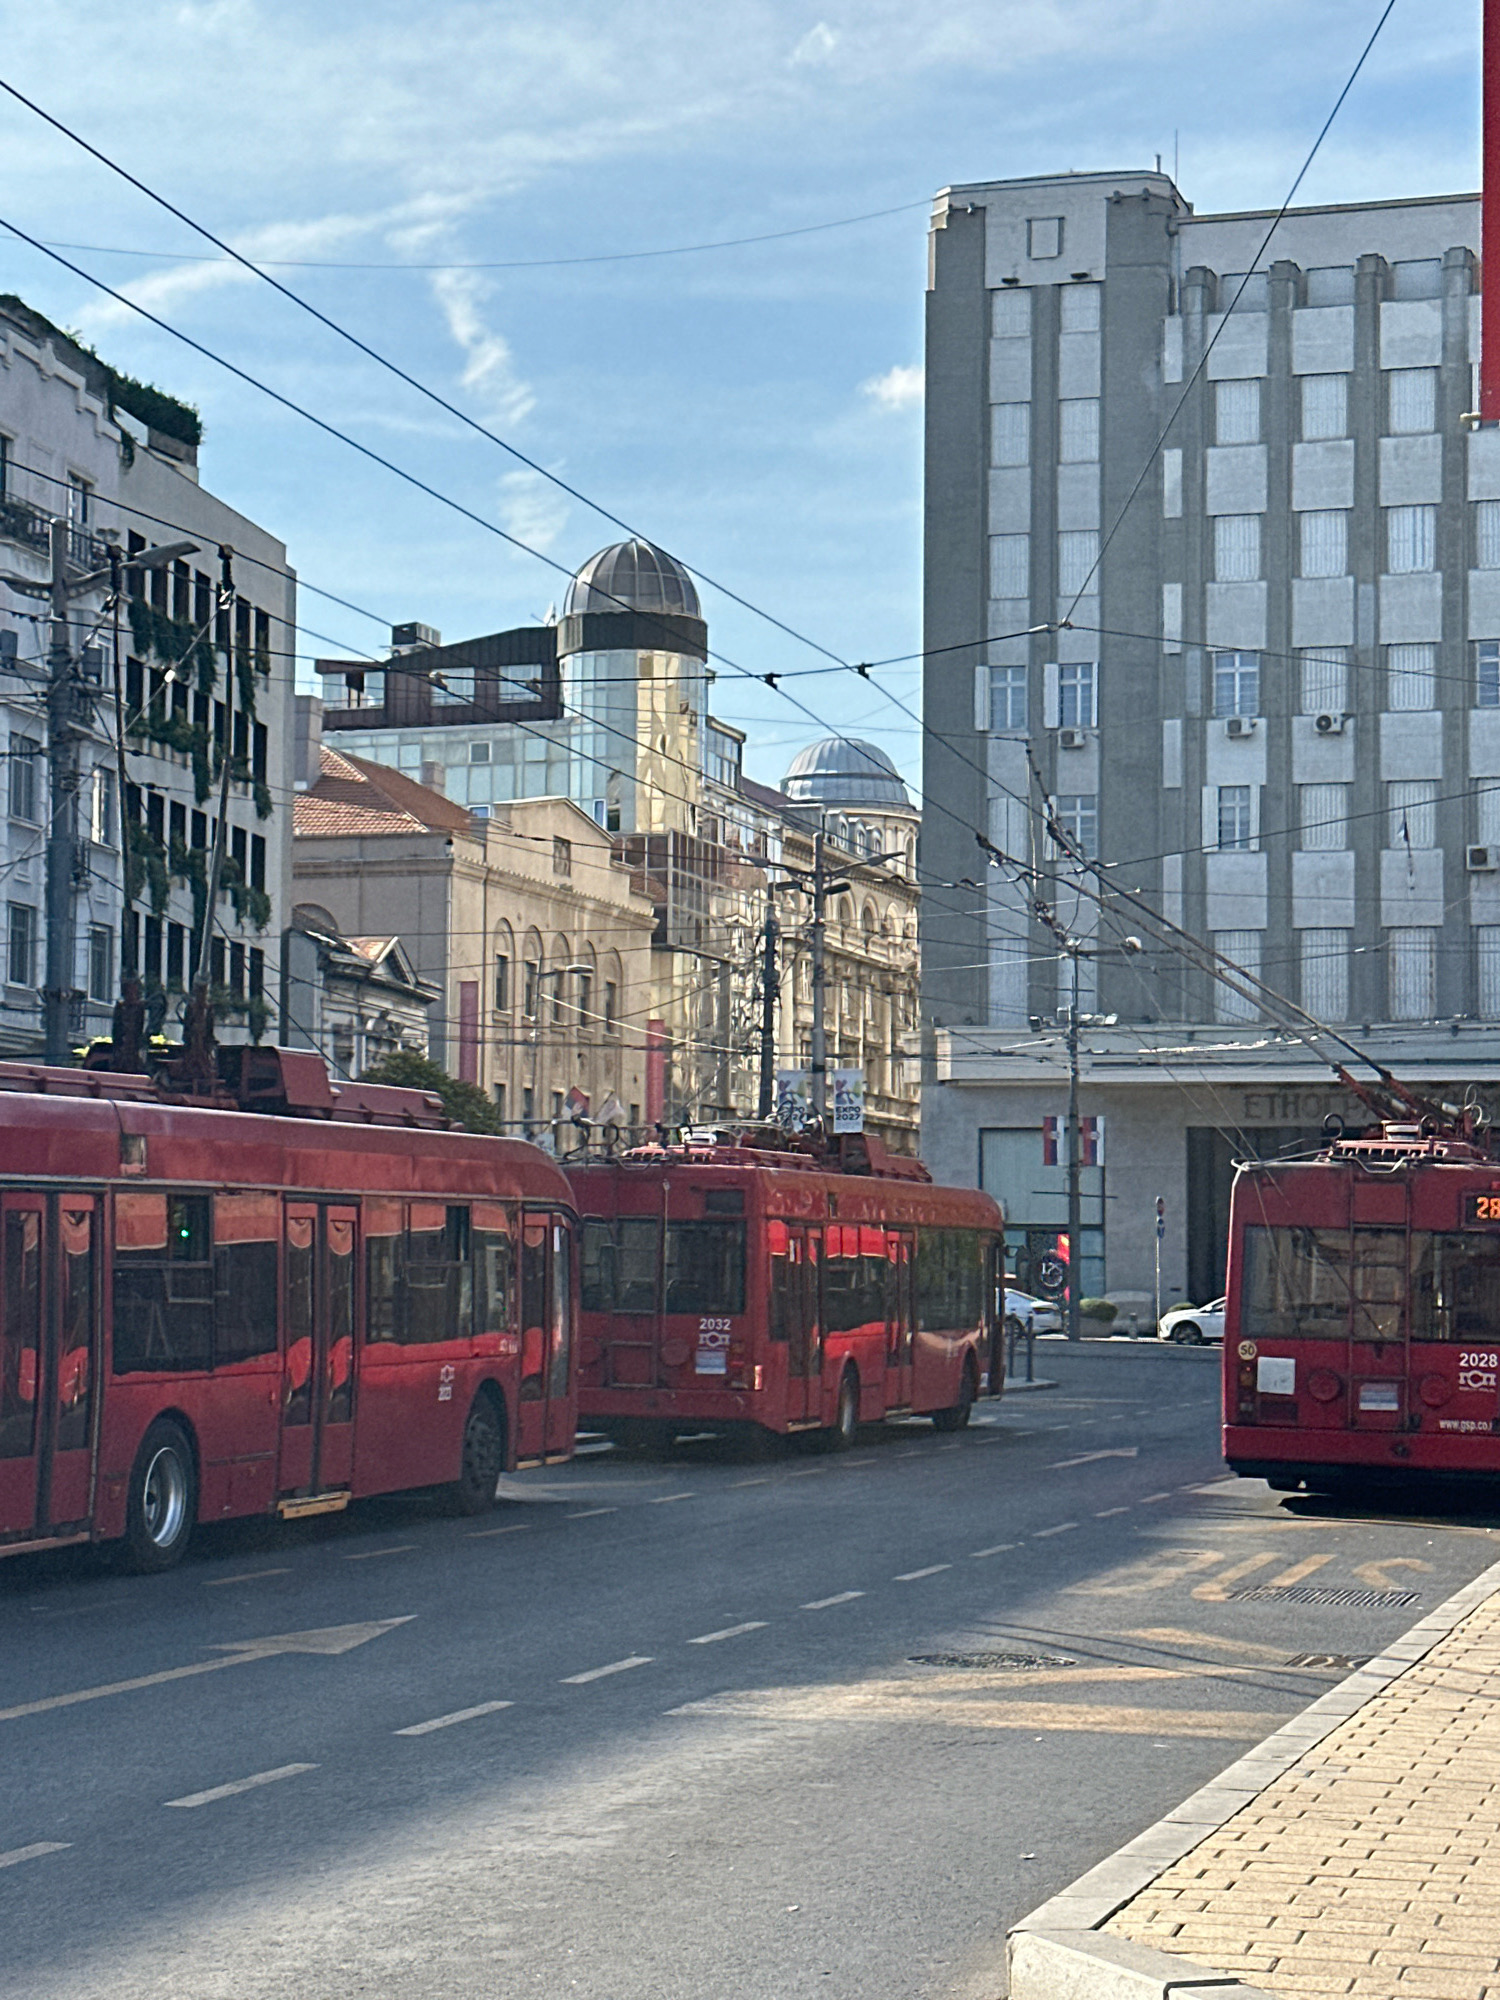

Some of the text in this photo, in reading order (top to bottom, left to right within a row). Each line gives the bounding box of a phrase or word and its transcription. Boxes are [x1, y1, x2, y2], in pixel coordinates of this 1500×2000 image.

[835, 1113, 861, 1121] 2027
[699, 1318, 732, 1331] 2032
[1459, 1352, 1498, 1368] 2028
